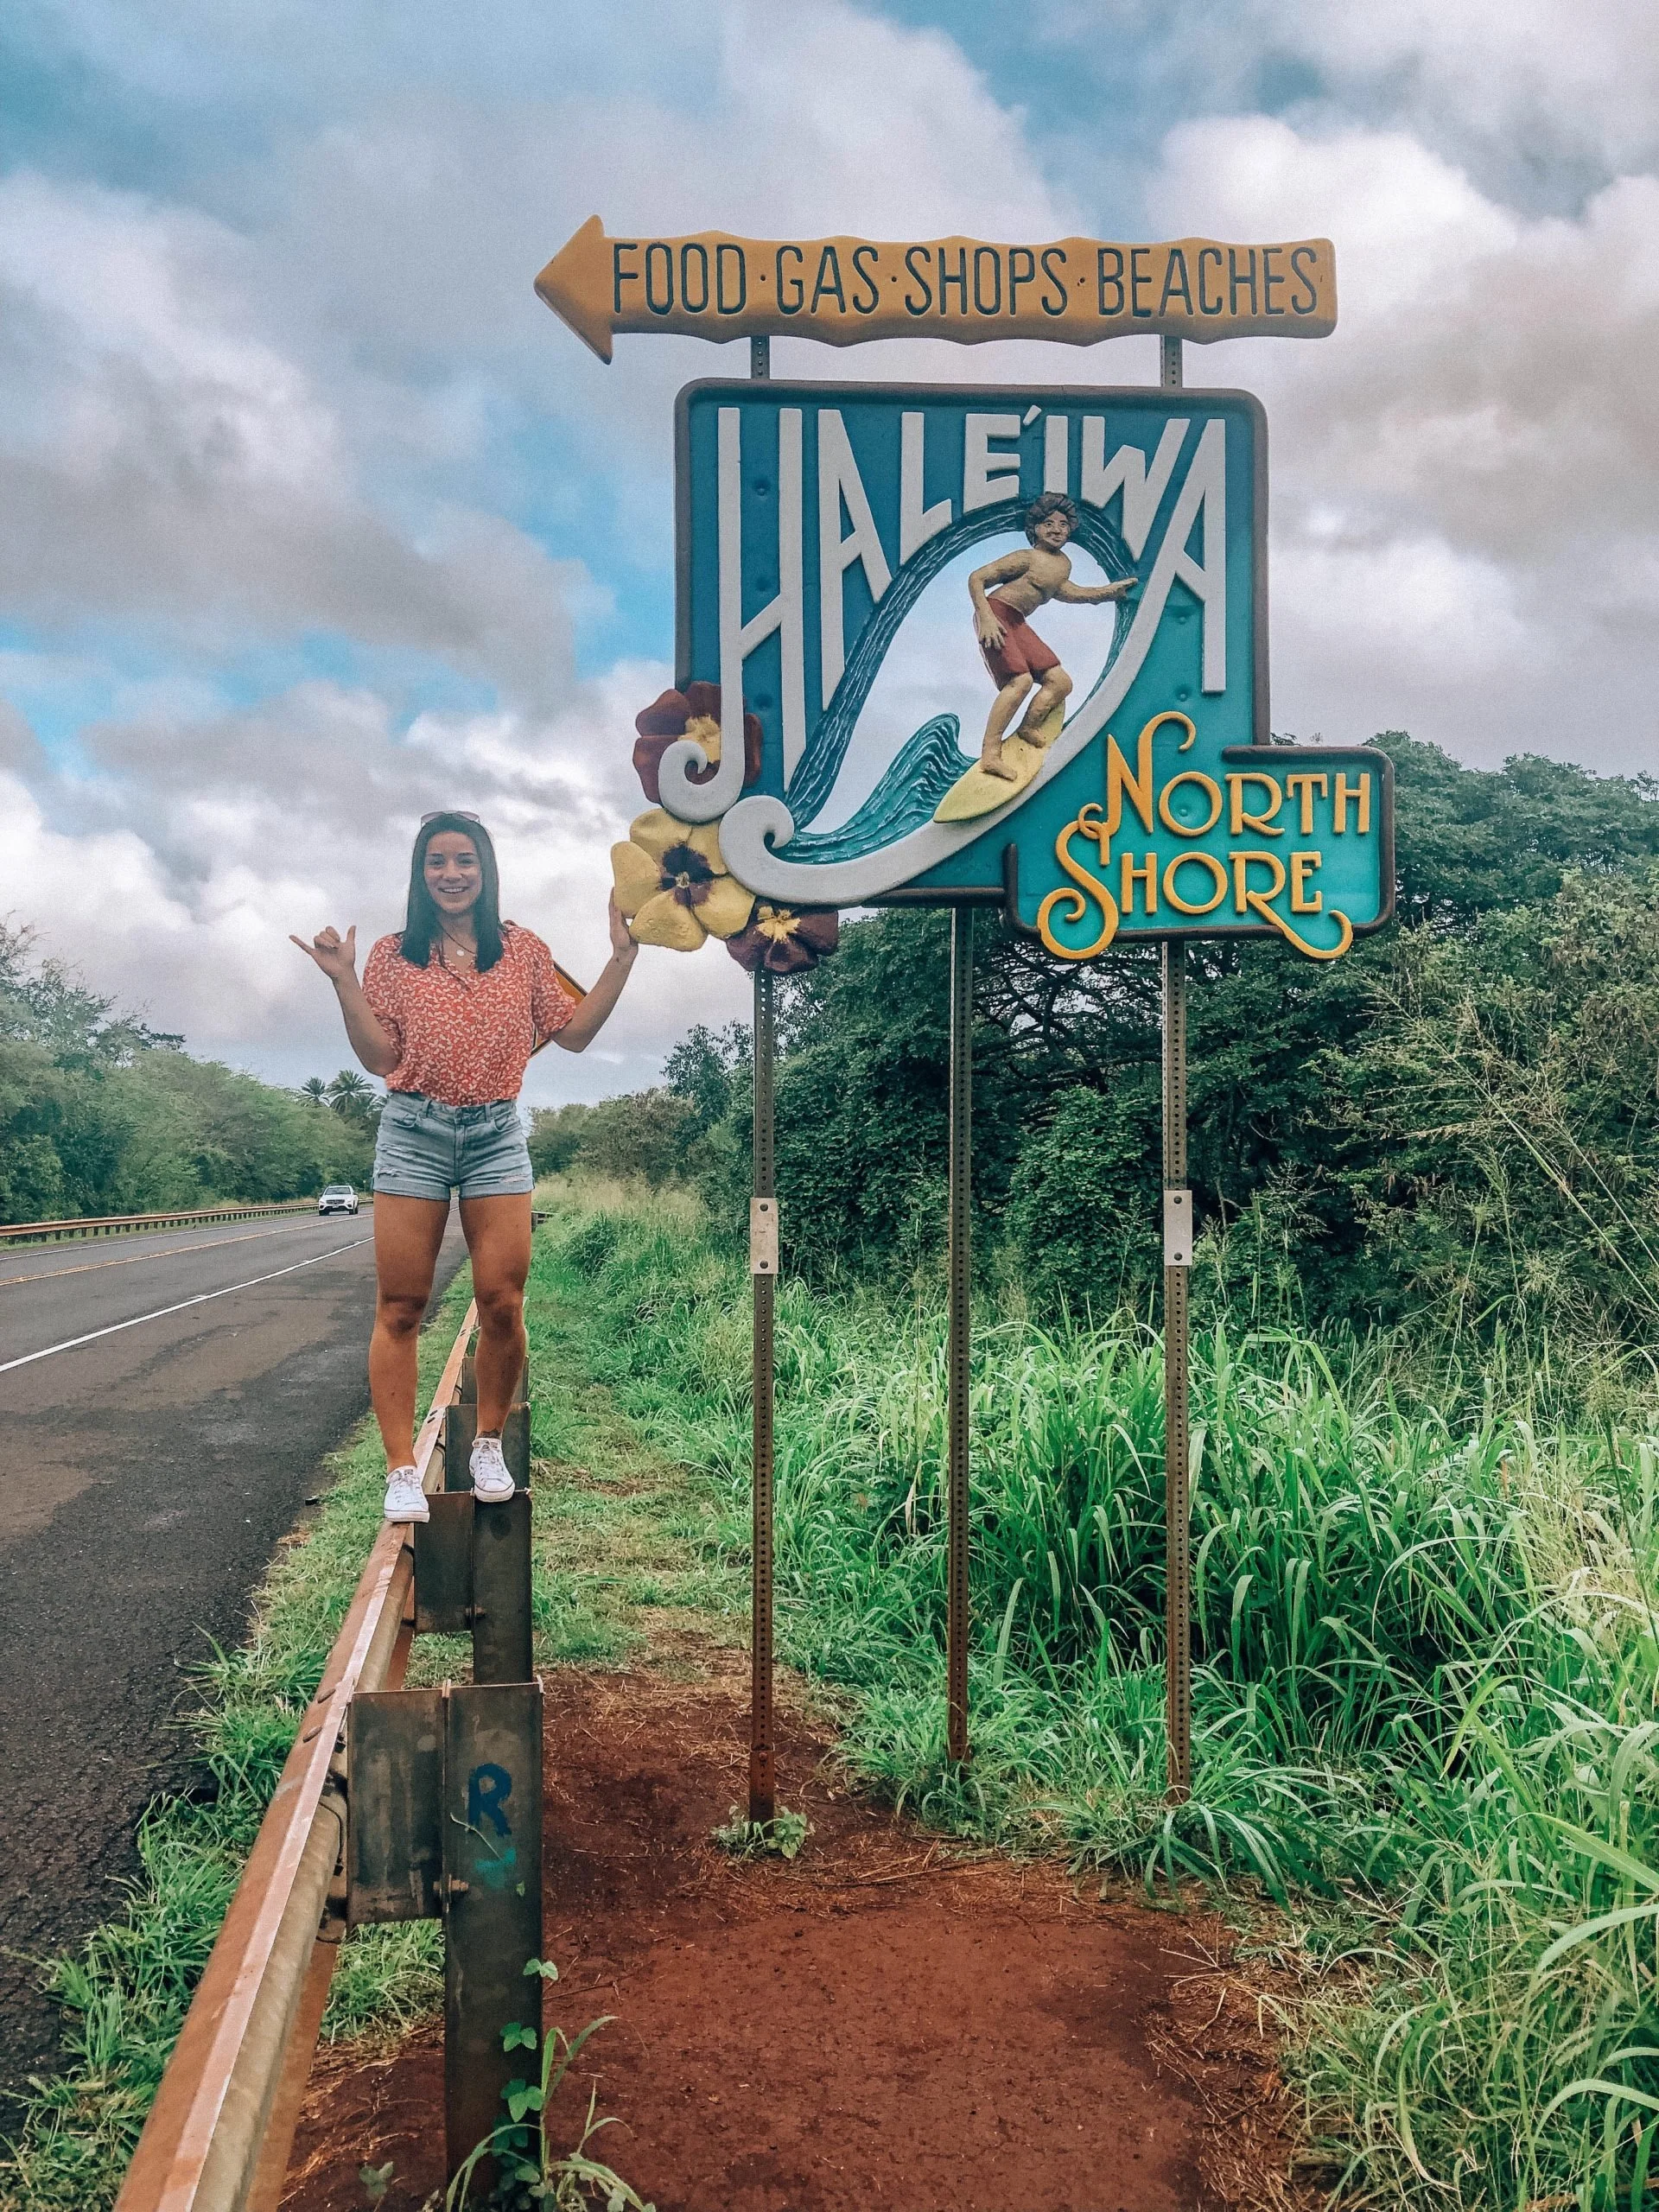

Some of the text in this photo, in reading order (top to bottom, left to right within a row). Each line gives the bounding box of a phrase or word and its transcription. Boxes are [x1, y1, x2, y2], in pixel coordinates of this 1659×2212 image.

[613, 243, 1318, 318] FOOD GAS SHOPS BEACHES
[1079, 710, 1370, 840] NORTH
[1037, 820, 1353, 959] SHORE
[467, 1762, 512, 1838] R
